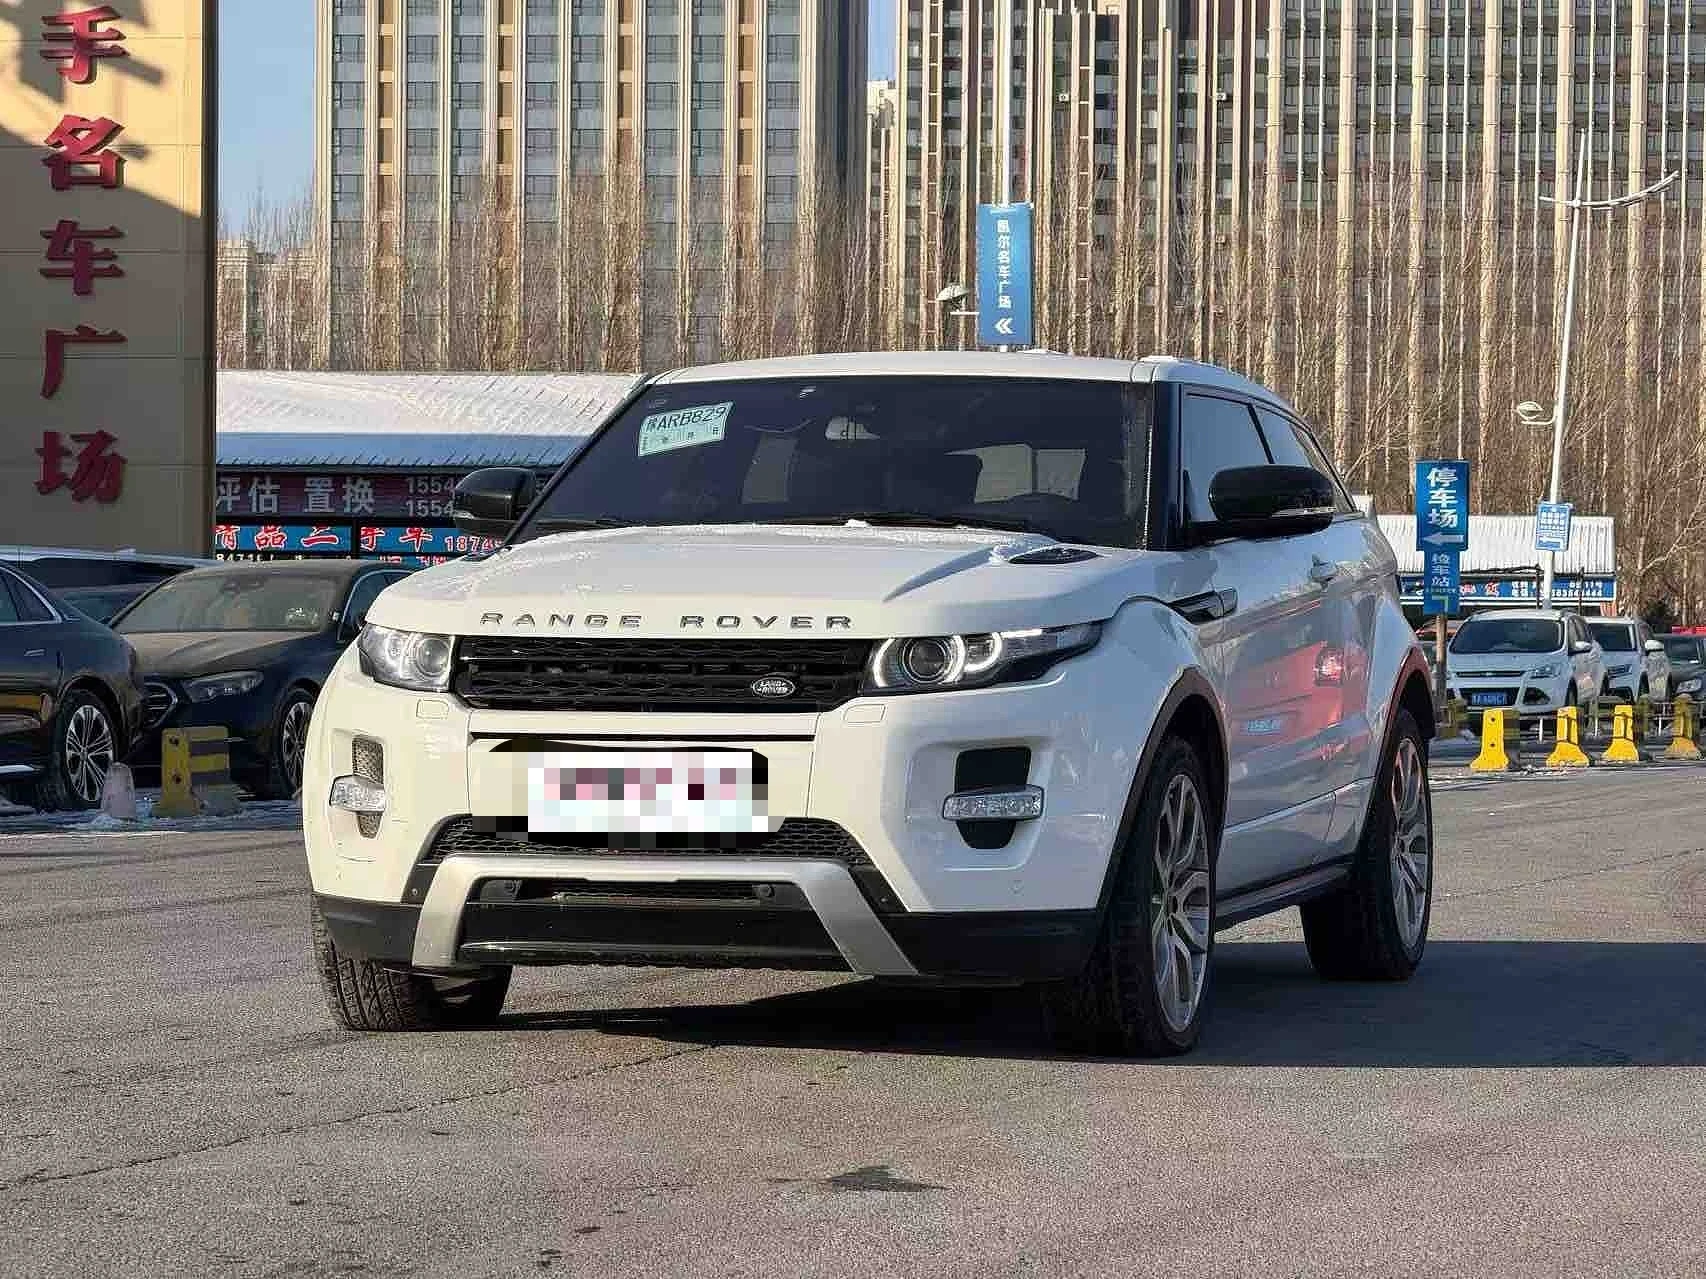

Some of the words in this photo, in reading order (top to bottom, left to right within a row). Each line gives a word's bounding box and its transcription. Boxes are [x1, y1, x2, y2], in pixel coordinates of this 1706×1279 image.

[35, 6, 128, 505] 手名车广场
[304, 476, 375, 513] 置换
[1427, 467, 1458, 528] 停车场
[480, 612, 642, 629] RANGE
[679, 615, 852, 630] ROVER
